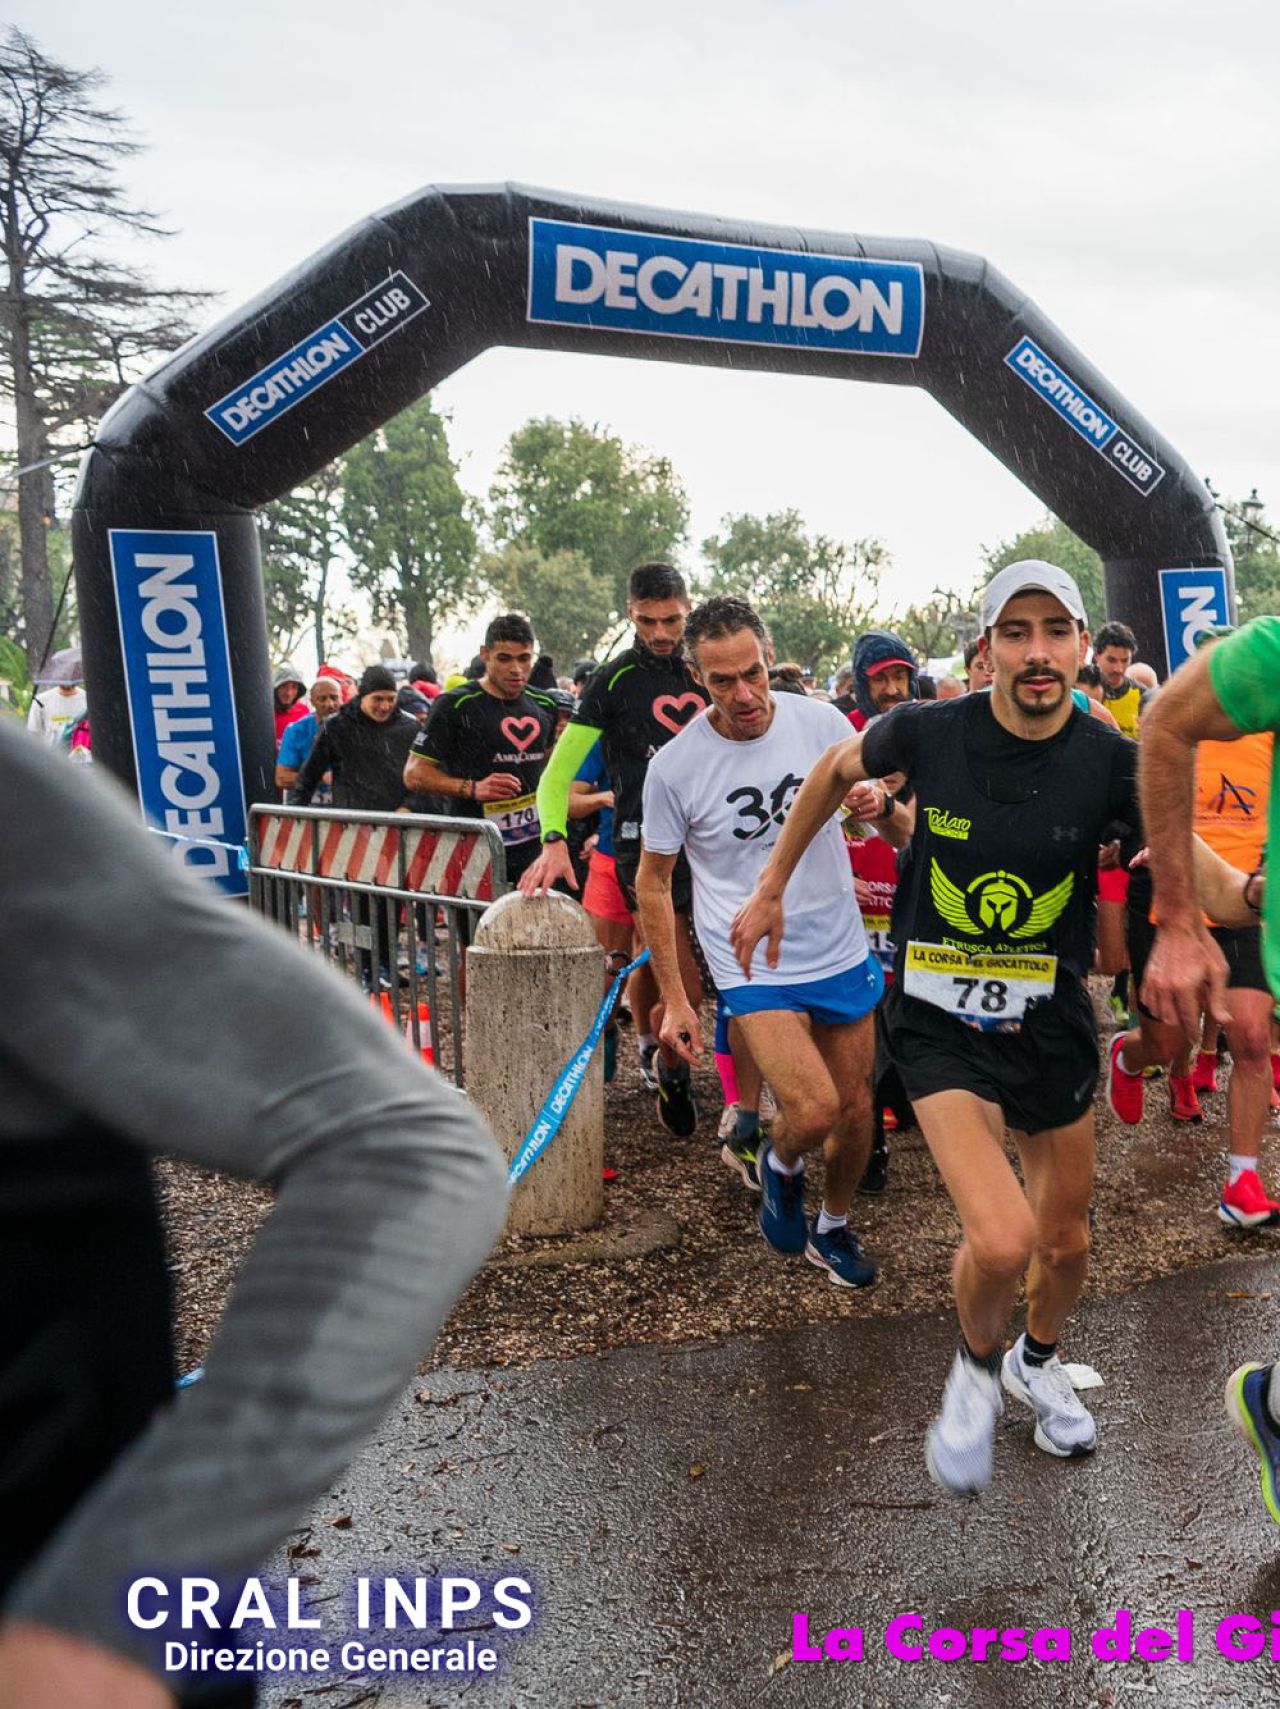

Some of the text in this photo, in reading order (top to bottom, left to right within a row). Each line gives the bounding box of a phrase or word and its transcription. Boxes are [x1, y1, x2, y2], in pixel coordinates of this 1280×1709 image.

[554, 244, 904, 336] DECATHLON
[220, 287, 412, 432] DECATHLON CLUB
[1015, 346, 1154, 483] DECATHLON CLUB
[134, 552, 230, 878] DECATHLON
[501, 807, 535, 828] 170
[913, 949, 926, 961] LA
[928, 952, 962, 966] CORSA
[952, 976, 1008, 1013] 78
[550, 1046, 593, 1115] DECATHLON
